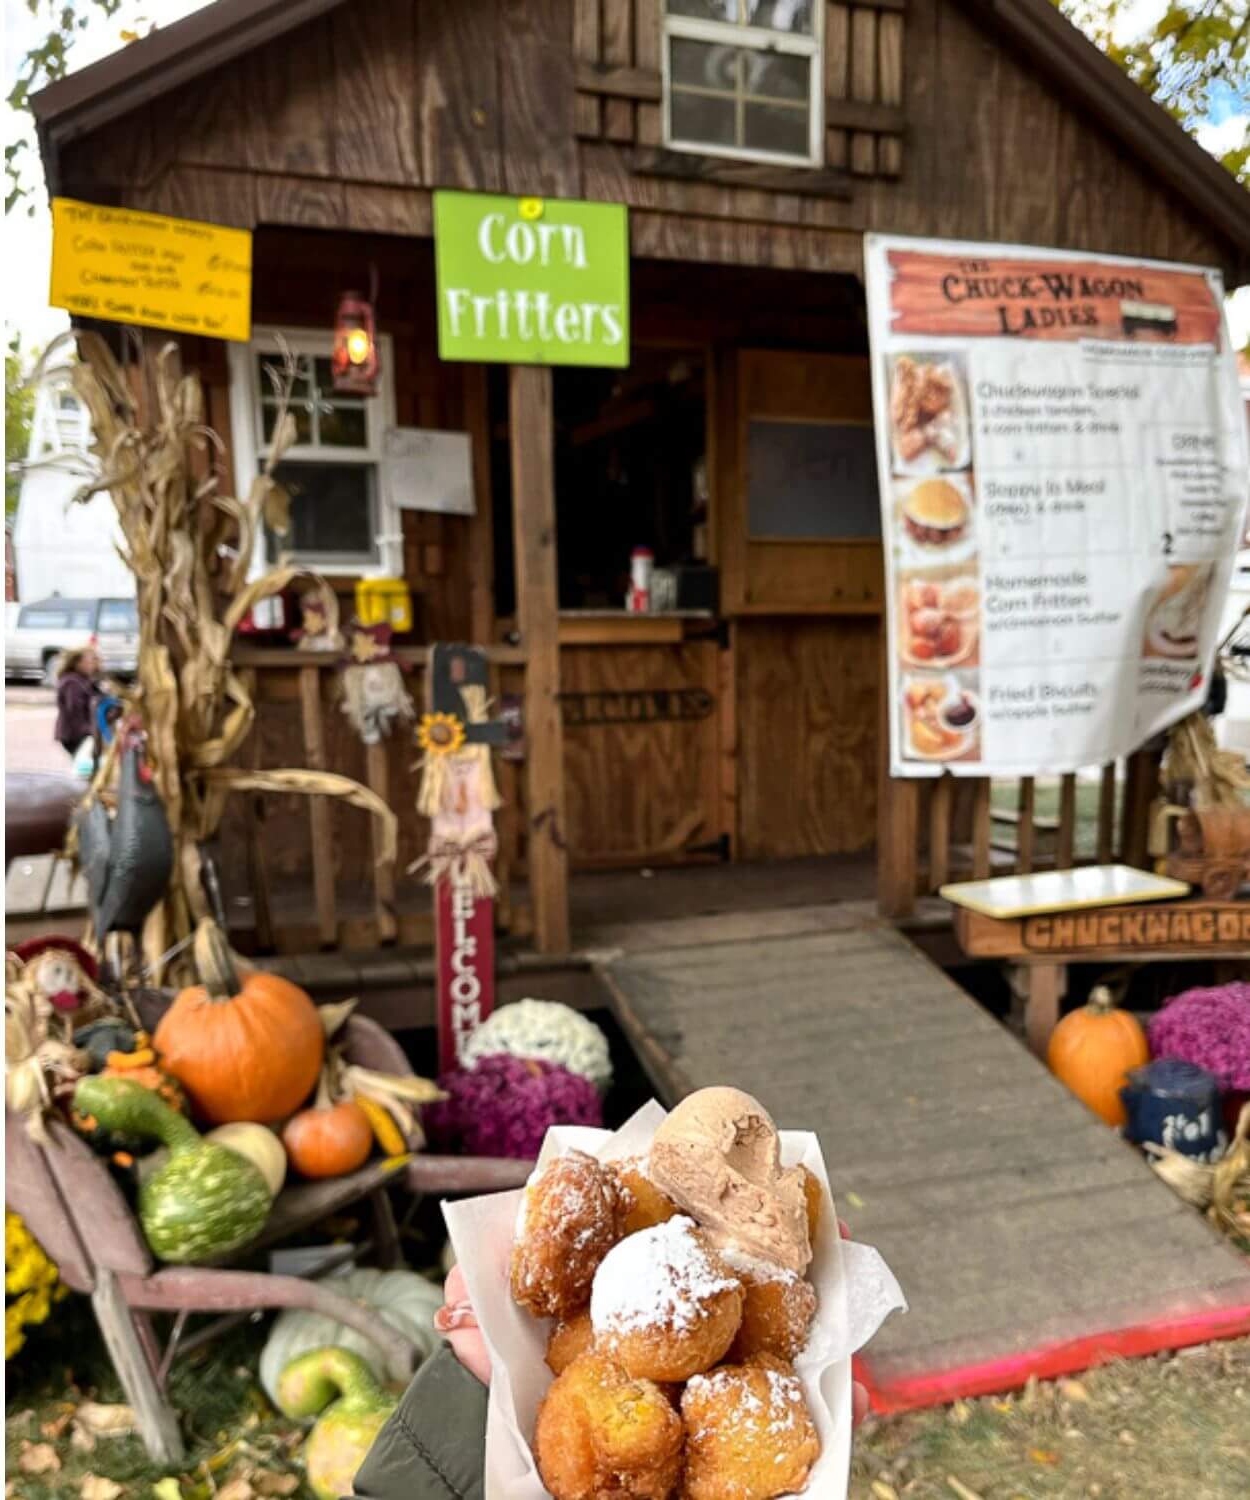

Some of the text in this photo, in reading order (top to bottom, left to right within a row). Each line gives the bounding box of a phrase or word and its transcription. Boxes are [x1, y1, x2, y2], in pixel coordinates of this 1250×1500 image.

[478, 213, 587, 269] Corn
[959, 259, 990, 273] THE
[446, 288, 623, 346] Fritters
[998, 304, 1099, 335] LADIES
[986, 596, 1028, 613] Corn
